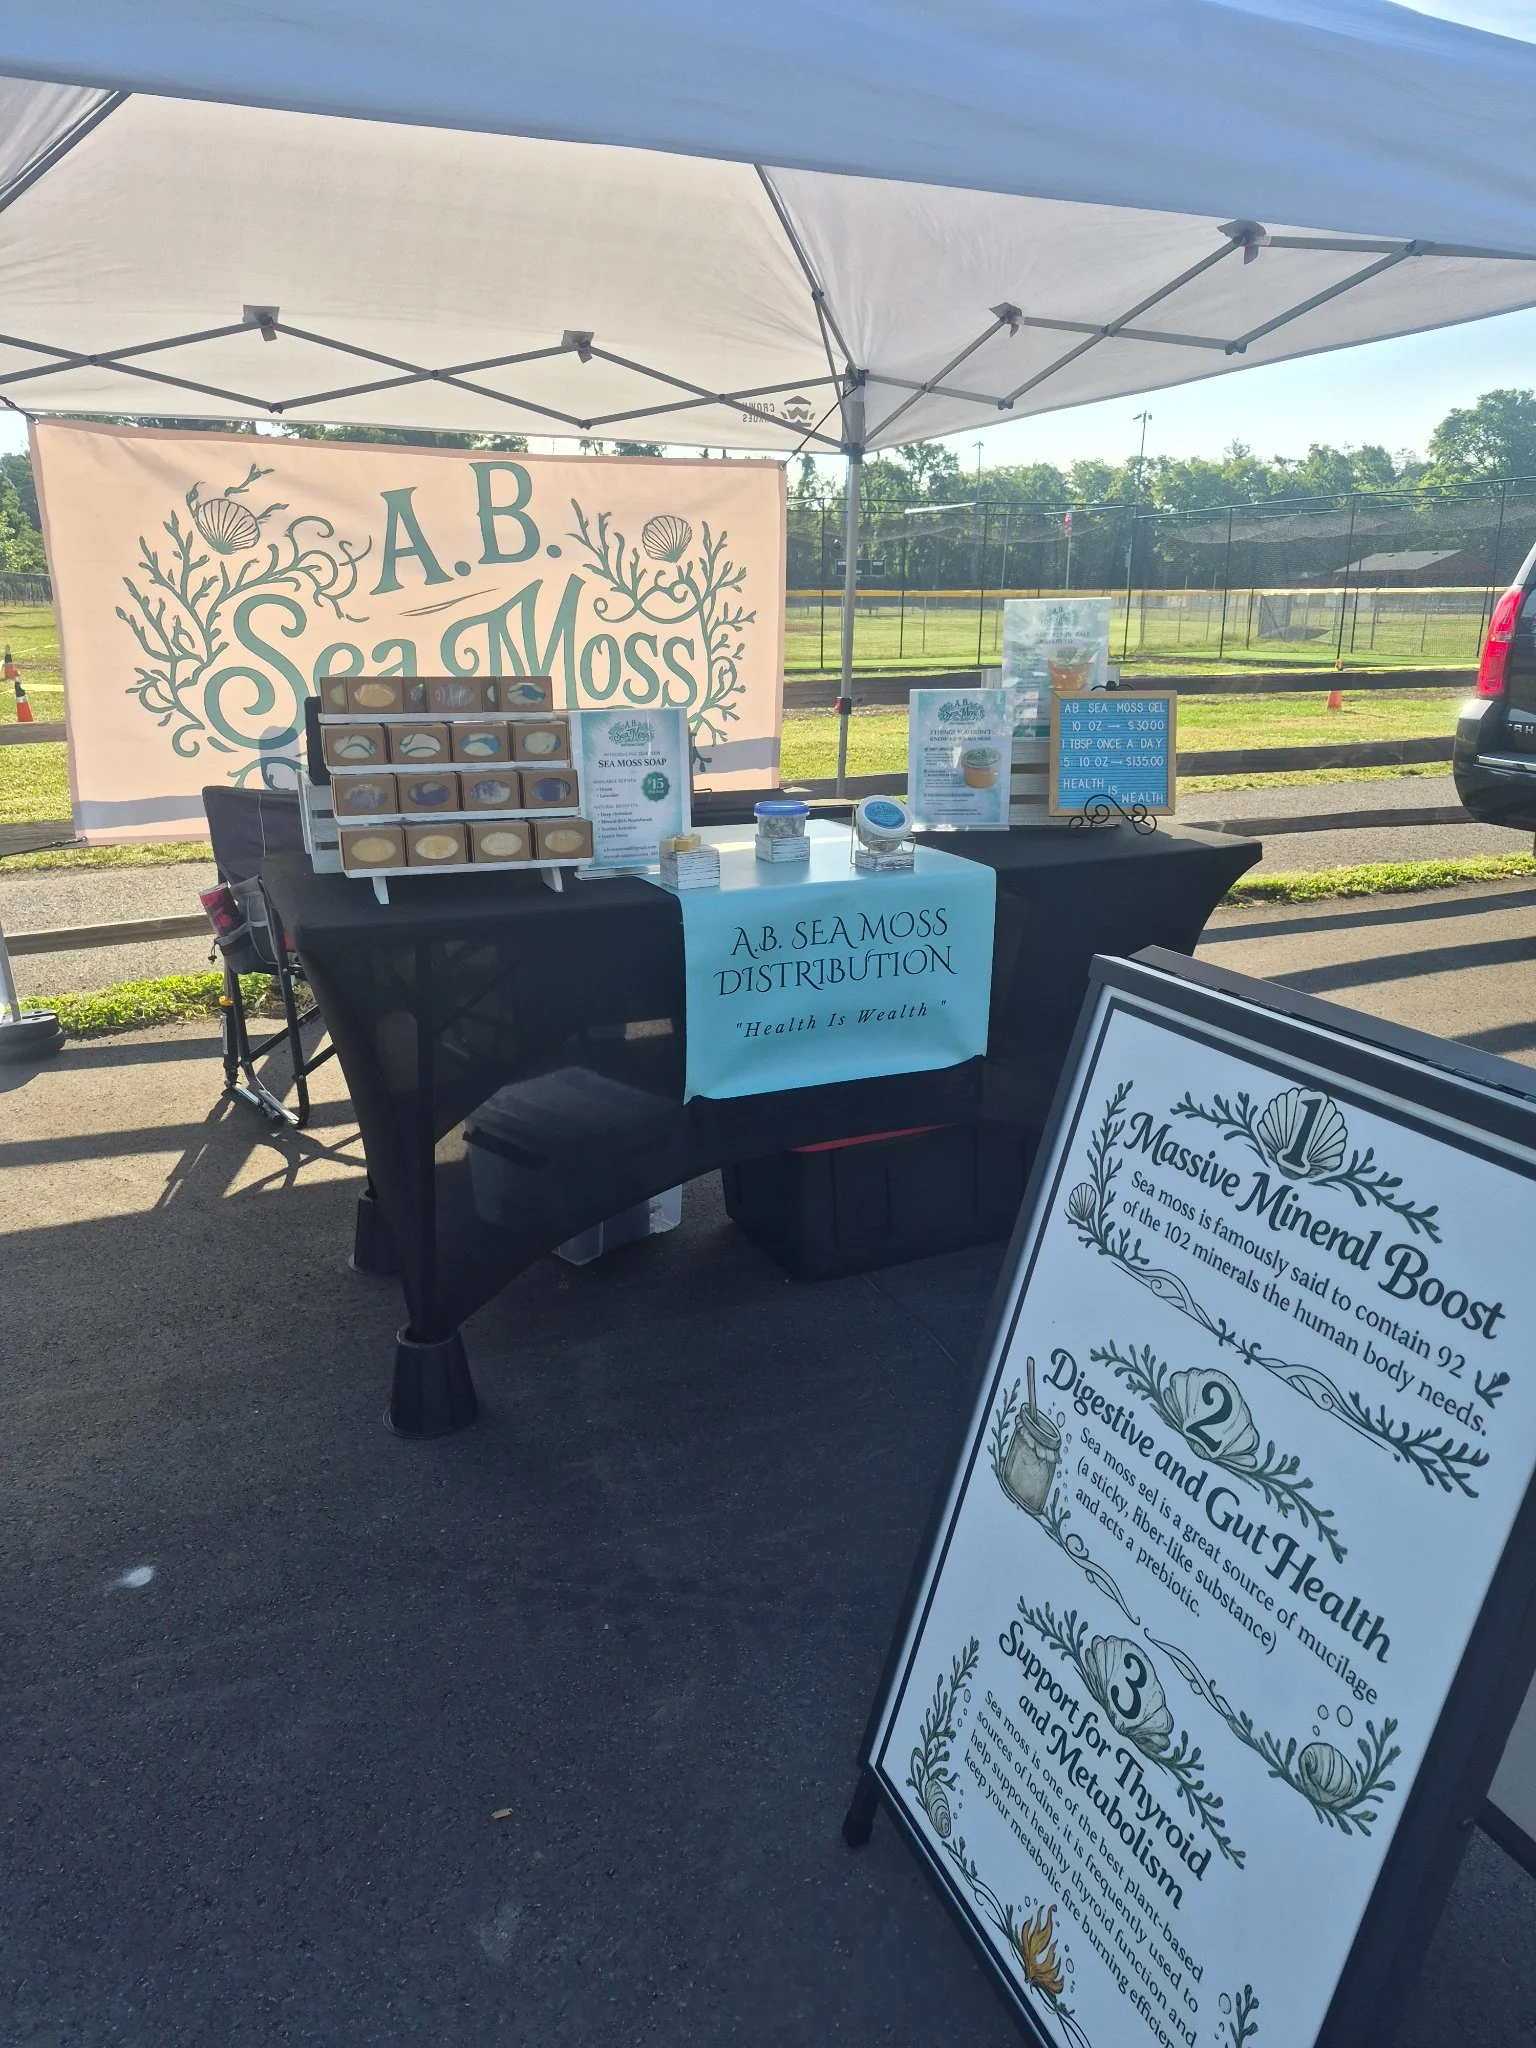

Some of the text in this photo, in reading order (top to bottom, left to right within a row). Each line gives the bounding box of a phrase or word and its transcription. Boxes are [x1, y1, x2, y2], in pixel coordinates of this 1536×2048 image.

[369, 461, 562, 595] A.B.
[204, 574, 698, 750] Sea Moss
[1065, 703, 1165, 713] AB SEA MOSS GEL
[598, 758, 667, 768] SEA MOSS SOAP
[1070, 739, 1092, 749] TBSP
[1097, 739, 1121, 749] ONCE
[1126, 739, 1134, 749] A
[1141, 739, 1163, 749] DAY
[1072, 721, 1081, 732] 10
[1088, 721, 1102, 731] OZ
[1080, 757, 1090, 767] 10
[1095, 757, 1108, 767] OZ
[1126, 756, 1164, 767] $135.00
[647, 778, 664, 789] $15
[1063, 778, 1104, 789] HEALTH
[1108, 785, 1118, 795] IS
[1121, 792, 1163, 803] WEALTH
[713, 944, 958, 996] DISTRIBUTION
[730, 907, 948, 959] A.B. SEA MOSS
[827, 1012, 846, 1028] Is
[1282, 1099, 1322, 1168] 1
[1123, 1112, 1506, 1339] Massive Mineral Boost
[1132, 1171, 1465, 1379] Sea moss is famously said to contain 92
[1123, 1201, 1486, 1436] of the 102 minerals the human body needs.
[1186, 1381, 1233, 1451] 2
[1043, 1348, 1390, 1663] Digestive and Gut Health
[1076, 1489, 1199, 1617] and acts a prebiotic.
[1078, 1456, 1276, 1655] (a sticky, fiber-like substance)
[1081, 1427, 1377, 1704] Sea moss gel is a great source of mucilage
[1111, 1653, 1148, 1719] 3
[999, 1621, 1211, 1881] Support for Thyroid
[985, 1690, 1203, 1983] Sea moss is one of the best plant-based
[1019, 1696, 1183, 1910] and Metabolism
[965, 1748, 986, 1788] keep
[986, 1784, 1010, 1819] your
[1010, 1818, 1061, 1894] metabolic
[1061, 1889, 1080, 1921] fire
[1081, 1914, 1129, 1994] burning
[971, 1729, 1197, 2048] help support healthy thyroid function and
[977, 1711, 1012, 1763] sources
[1015, 1762, 1027, 1779] of
[1063, 1824, 1072, 1844] it
[1073, 1838, 1083, 1858] is
[1085, 1854, 1147, 1944] frequently
[1149, 1942, 1182, 1991] used
[1184, 1988, 1198, 2013] to
